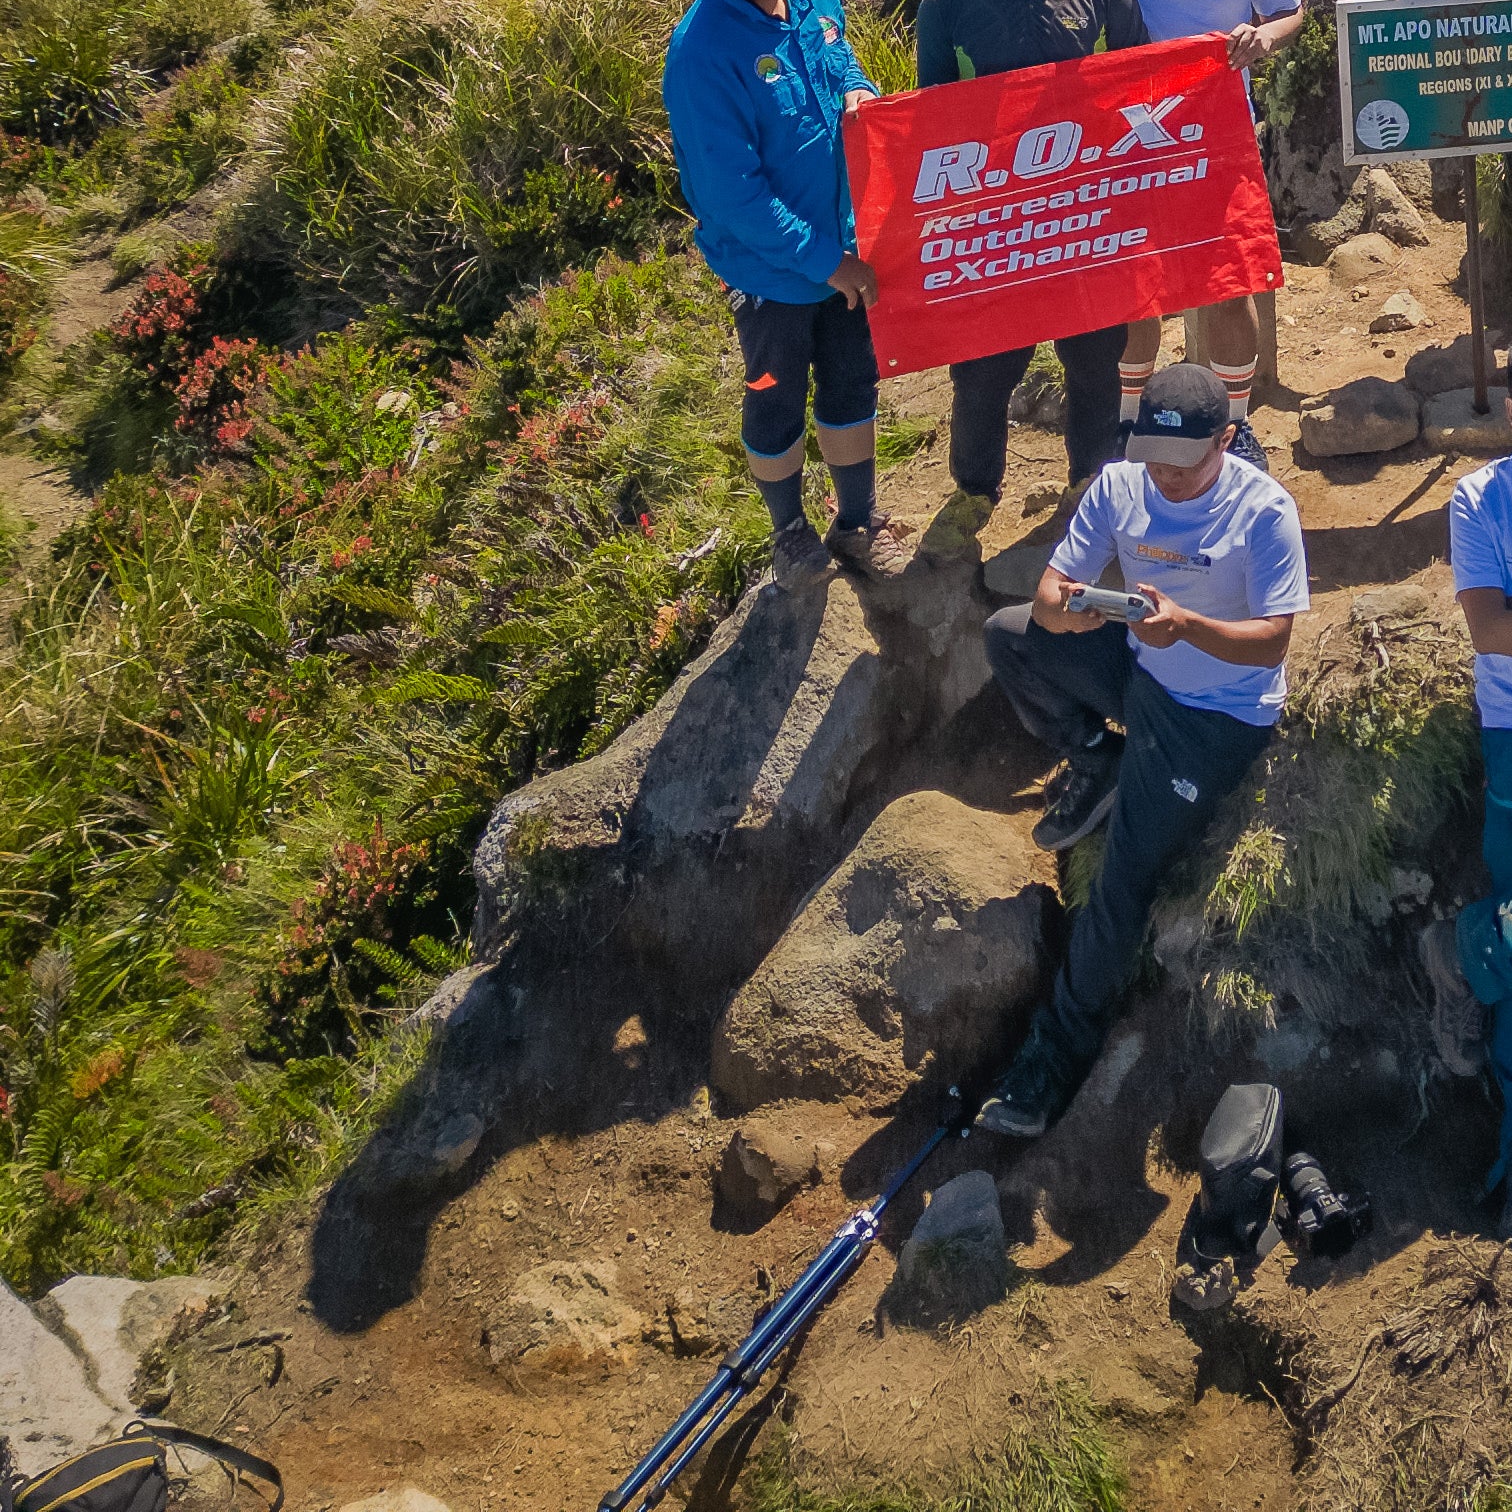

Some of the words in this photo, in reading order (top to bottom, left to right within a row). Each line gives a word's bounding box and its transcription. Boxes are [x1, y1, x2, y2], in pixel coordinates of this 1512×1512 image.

[1357, 23, 1389, 45] MT.
[1393, 19, 1432, 42] APO
[1368, 53, 1433, 73] REGIONAL
[1418, 77, 1473, 96] REGIONS
[1475, 75, 1492, 94] (XI
[1494, 74, 1504, 88] &
[912, 94, 1204, 204] R.O.X.
[1467, 119, 1505, 138] MANP
[919, 157, 1209, 239] Recreational
[920, 207, 1112, 264] Outdoor
[923, 227, 1149, 290] eXchange
